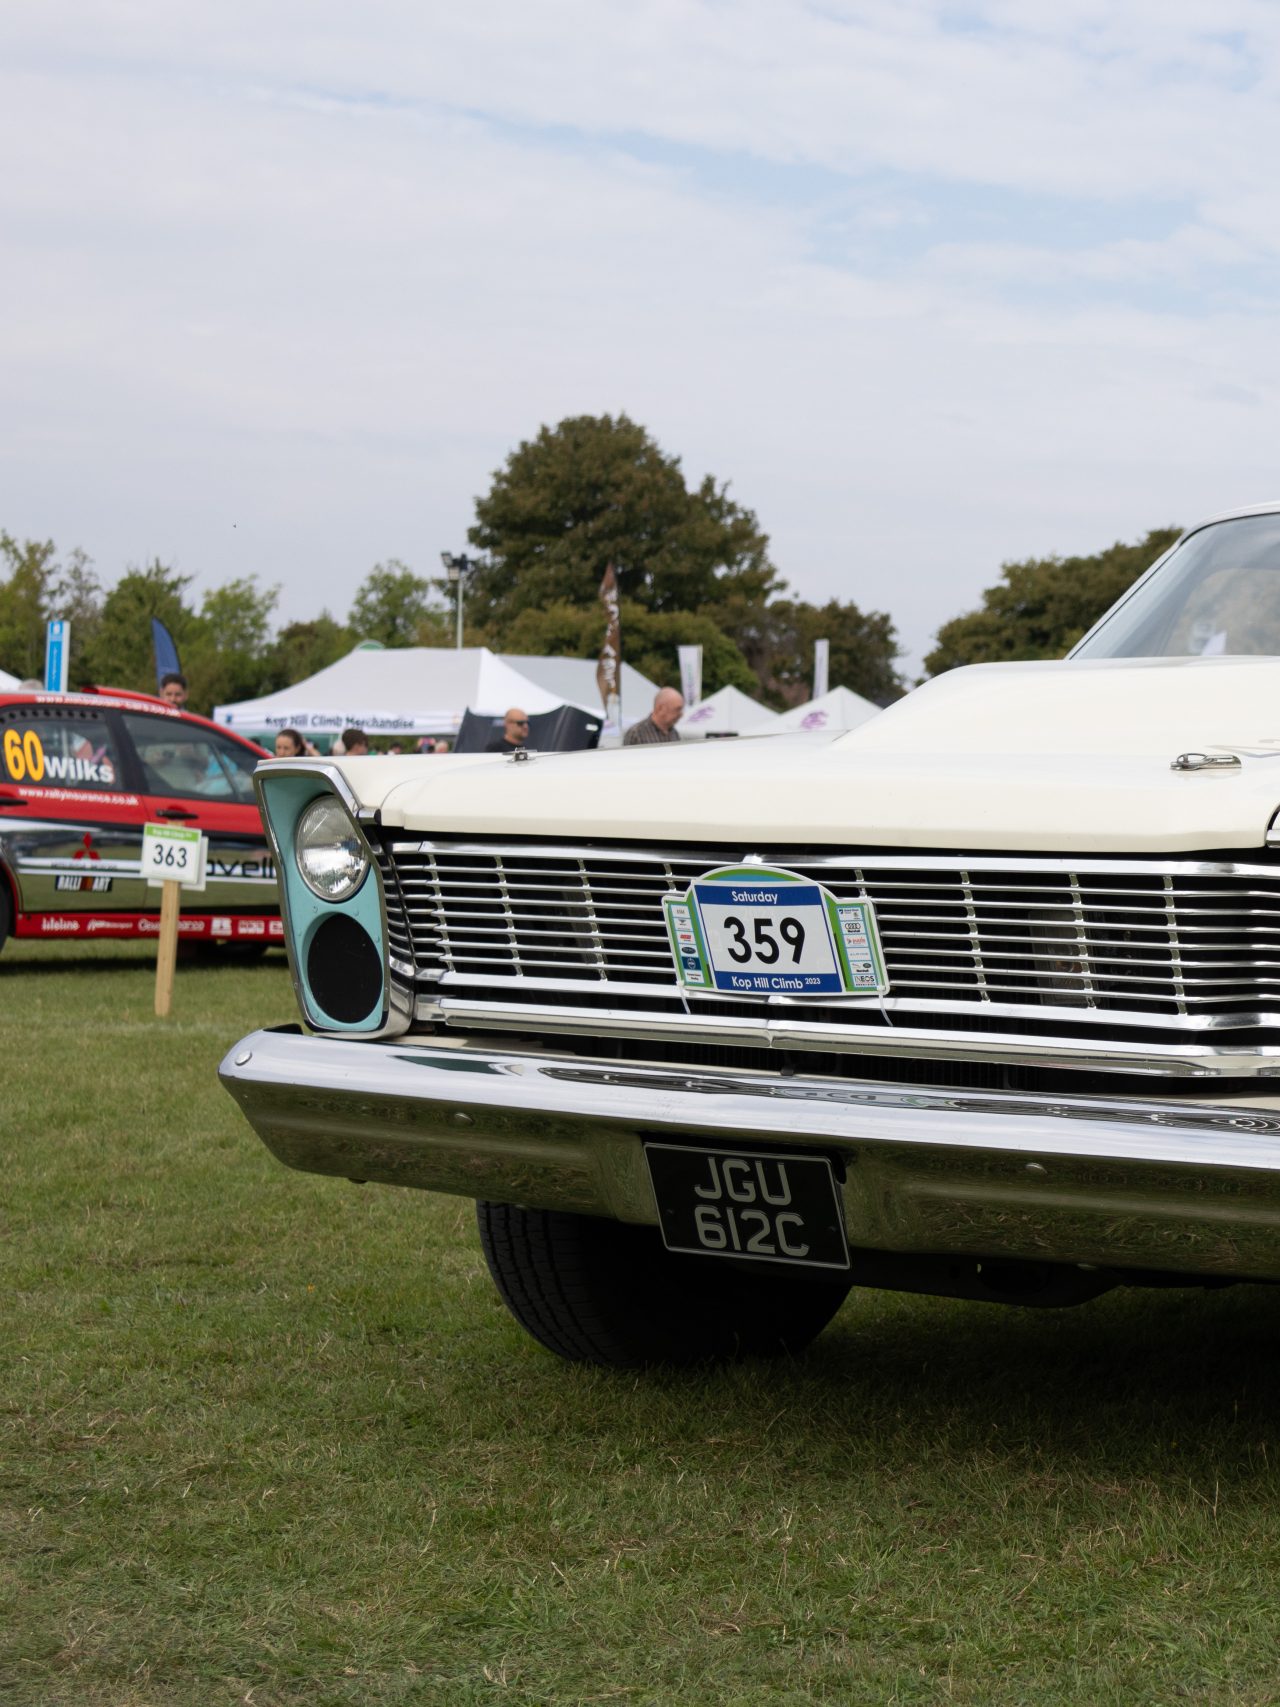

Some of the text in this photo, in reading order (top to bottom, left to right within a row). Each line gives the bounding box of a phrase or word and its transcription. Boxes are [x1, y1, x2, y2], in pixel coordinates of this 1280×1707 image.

[265, 714, 415, 729] Kop Hill Climb Merchandise
[4, 729, 44, 782] 60
[44, 756, 114, 783] Wilks
[153, 844, 188, 868] 363
[731, 890, 778, 905] Saturday
[723, 916, 806, 965] 359
[731, 976, 821, 990] Kop Hill Climb 2023
[694, 1156, 792, 1206] JGU
[694, 1204, 810, 1257] 612C
